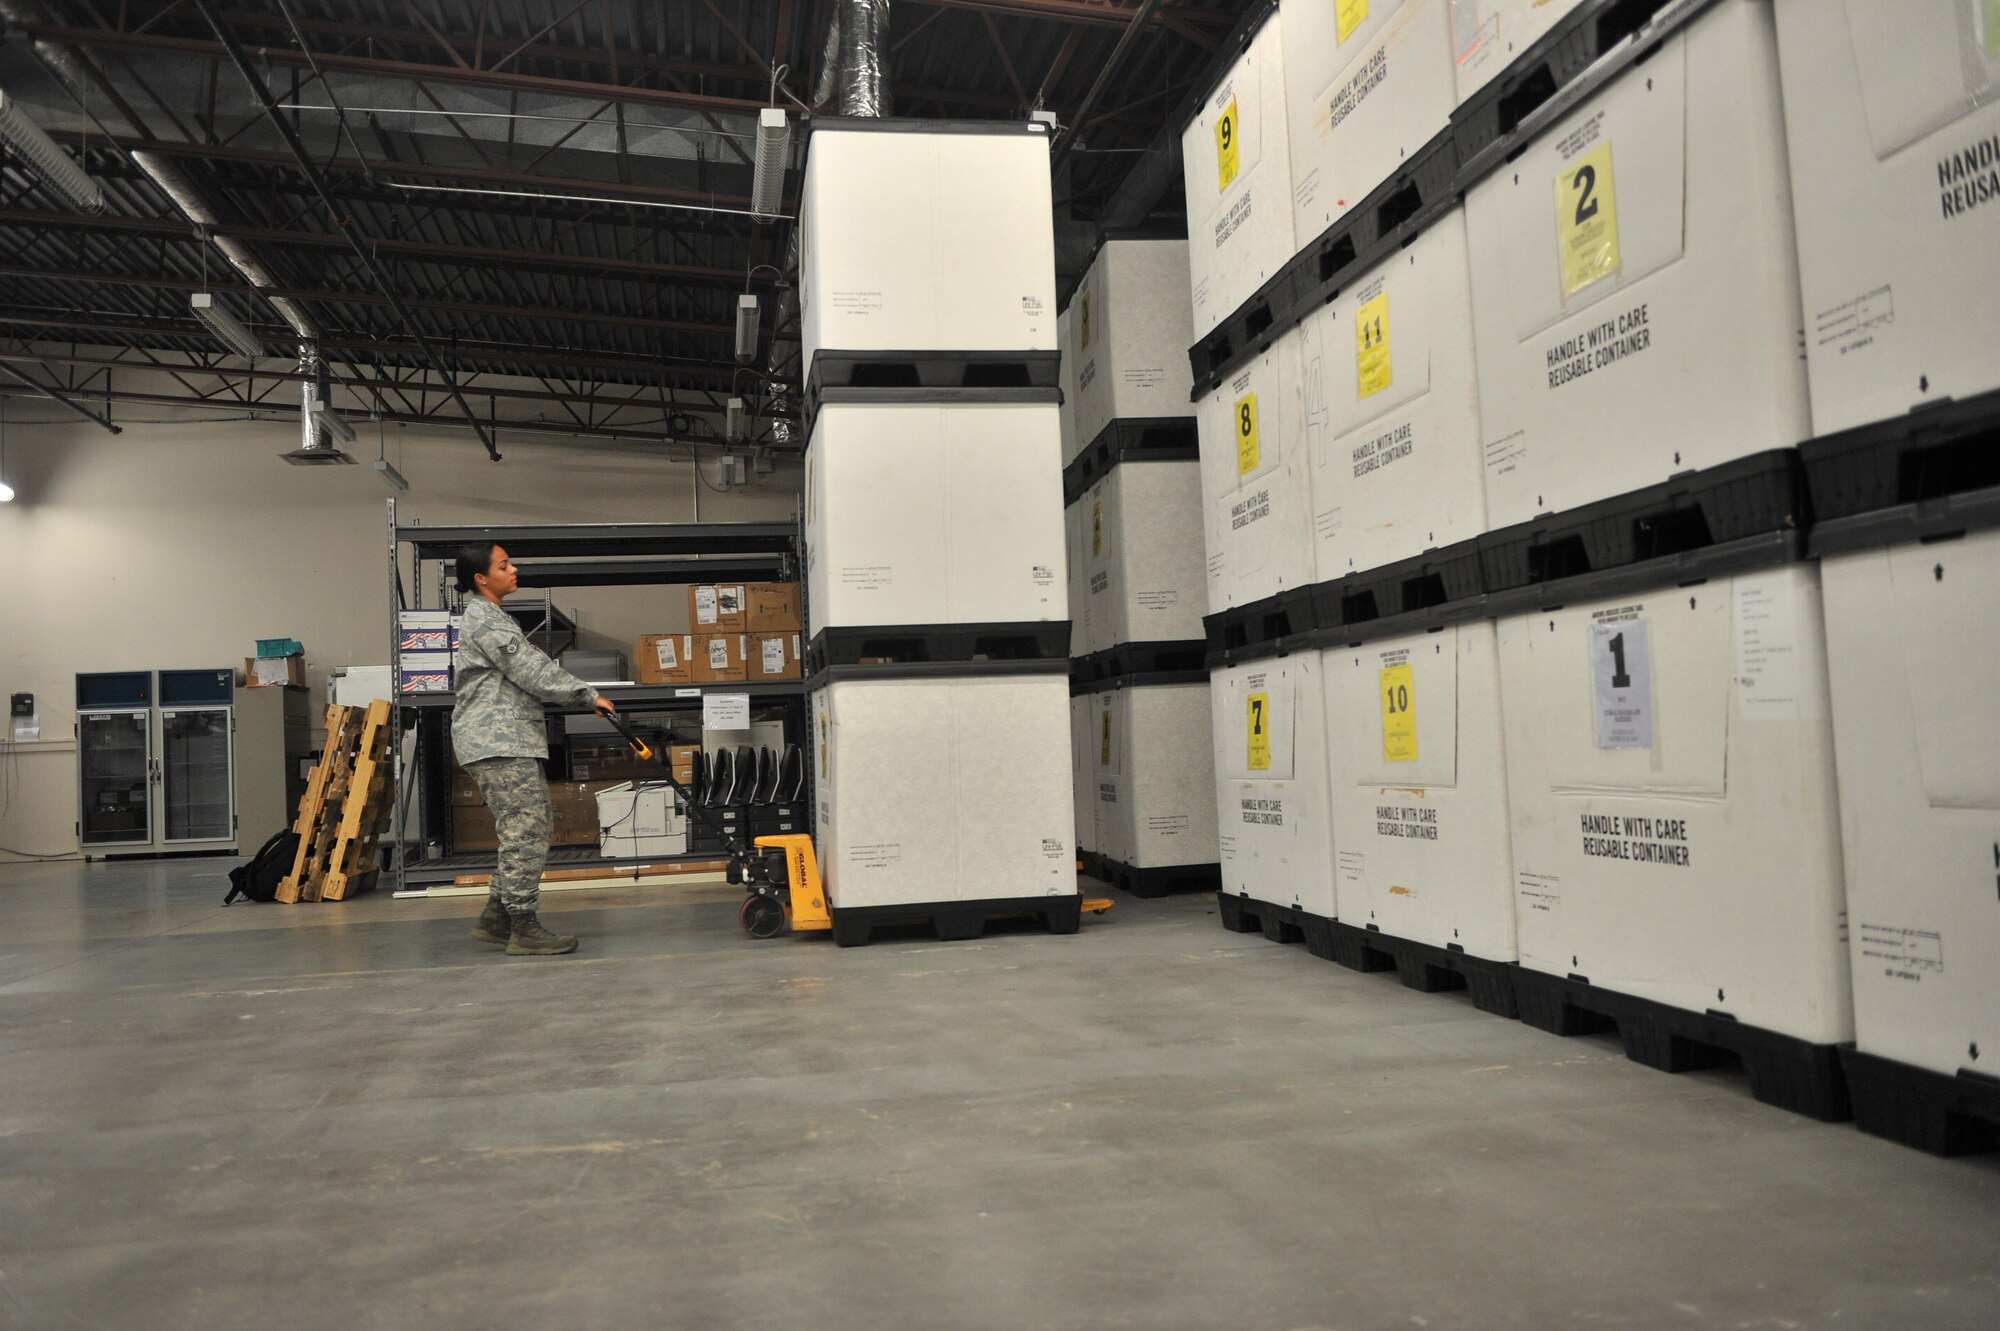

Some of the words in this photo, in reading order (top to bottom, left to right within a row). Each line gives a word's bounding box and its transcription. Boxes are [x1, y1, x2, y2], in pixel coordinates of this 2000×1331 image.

[1330, 81, 1351, 113] HANDLE
[1352, 64, 1369, 90] WITH
[1370, 46, 1386, 73] CARE
[1331, 94, 1356, 129] REUSABLE
[1357, 63, 1387, 103] CONTAINER
[1222, 116, 1231, 150] 9
[1573, 165, 1598, 226] 2
[1363, 315, 1382, 349] 11
[1547, 334, 1585, 367] HANDLE
[1587, 320, 1615, 348] WITH
[1618, 303, 1648, 334] CARE
[1549, 353, 1592, 389] REUSABLE
[1595, 328, 1650, 368] CONTAINER
[1241, 403, 1251, 437] 8
[1352, 440, 1375, 462] HANDLE
[1376, 432, 1393, 451] WITH
[1394, 422, 1411, 443] CARE
[1354, 455, 1380, 478] REUSABLE
[1381, 440, 1412, 465] CONTAINER
[1609, 632, 1630, 688] 1
[1388, 684, 1408, 714] 10
[1252, 700, 1262, 735] 7
[1241, 799, 1257, 810] HANDLE
[1257, 799, 1269, 811] WITH
[1269, 799, 1282, 812] CARE
[1242, 811, 1261, 824] REUSABLE
[1260, 813, 1283, 826] CONTAINER
[1376, 806, 1399, 820] HANDLE
[1400, 807, 1418, 822] WITH
[1419, 808, 1437, 823] CARE
[1377, 822, 1404, 837] REUSABLE
[1405, 824, 1438, 840] CONTAINER
[1581, 814, 1621, 836] HANDLE
[1622, 816, 1653, 838] WITH
[1655, 818, 1687, 841] CARE
[1583, 837, 1630, 860] REUSABLE
[1632, 841, 1690, 867] CONTAINER
[799, 853, 807, 888] GLOBAL
